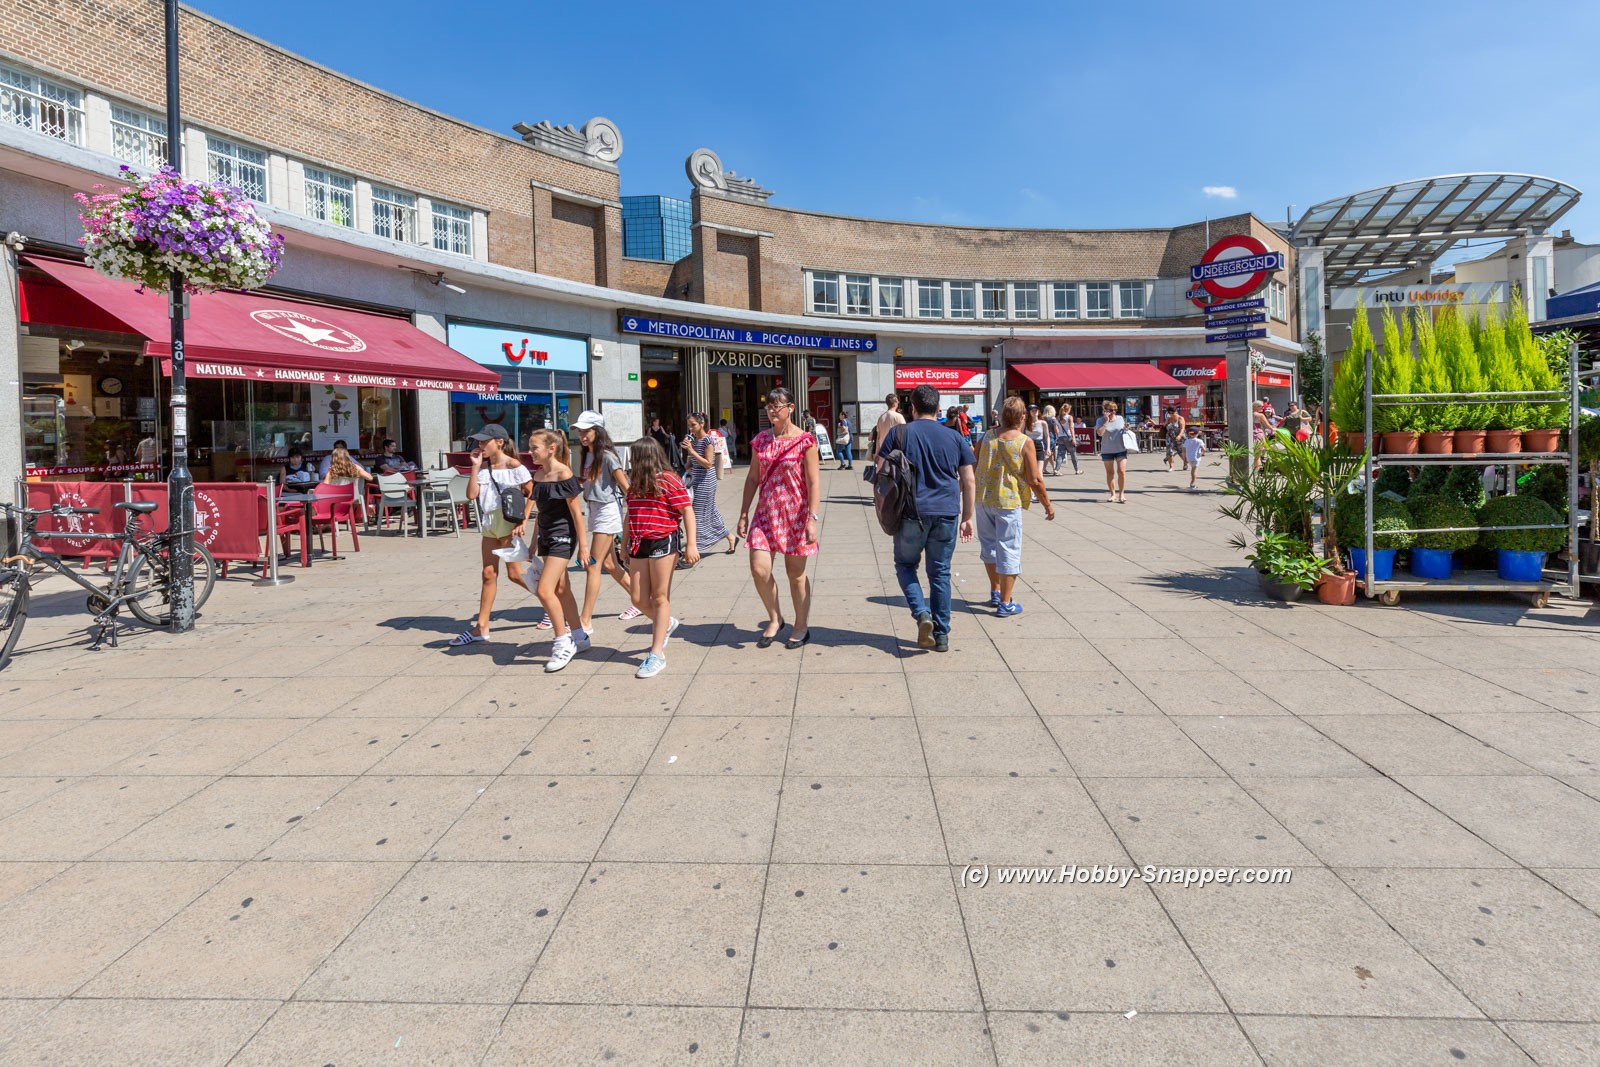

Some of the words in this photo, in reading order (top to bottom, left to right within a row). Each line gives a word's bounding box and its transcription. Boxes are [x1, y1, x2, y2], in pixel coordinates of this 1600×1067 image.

[1192, 255, 1277, 280] UNDERGROUND
[1375, 290, 1405, 303] intu
[1409, 289, 1465, 302] Uxbridge
[1209, 304, 1236, 312] UXBRIDGE
[1236, 300, 1259, 309] STATION
[1208, 317, 1248, 326] METROPOLITAN
[648, 320, 735, 341] METROPOLITAN
[745, 331, 753, 342] &
[762, 333, 822, 348] PICCADILLY
[832, 338, 861, 349] LINES
[1214, 332, 1243, 341] PICCADILLY
[530, 350, 549, 361] TUI
[196, 363, 247, 377] NATURAL
[275, 370, 326, 382] HANDMADE
[348, 374, 397, 386] SANDWICHES
[415, 379, 454, 390] CAPPUCCINO
[466, 383, 487, 392] SALADS
[896, 369, 924, 379] Sweet
[925, 370, 959, 381] Express
[1172, 367, 1217, 377] Ladbrokes
[477, 392, 503, 401] TRAVEL
[504, 394, 528, 402] MONEY
[26, 468, 54, 477] LATTE
[197, 492, 220, 518] COFFEE
[203, 529, 218, 547] FOOD
